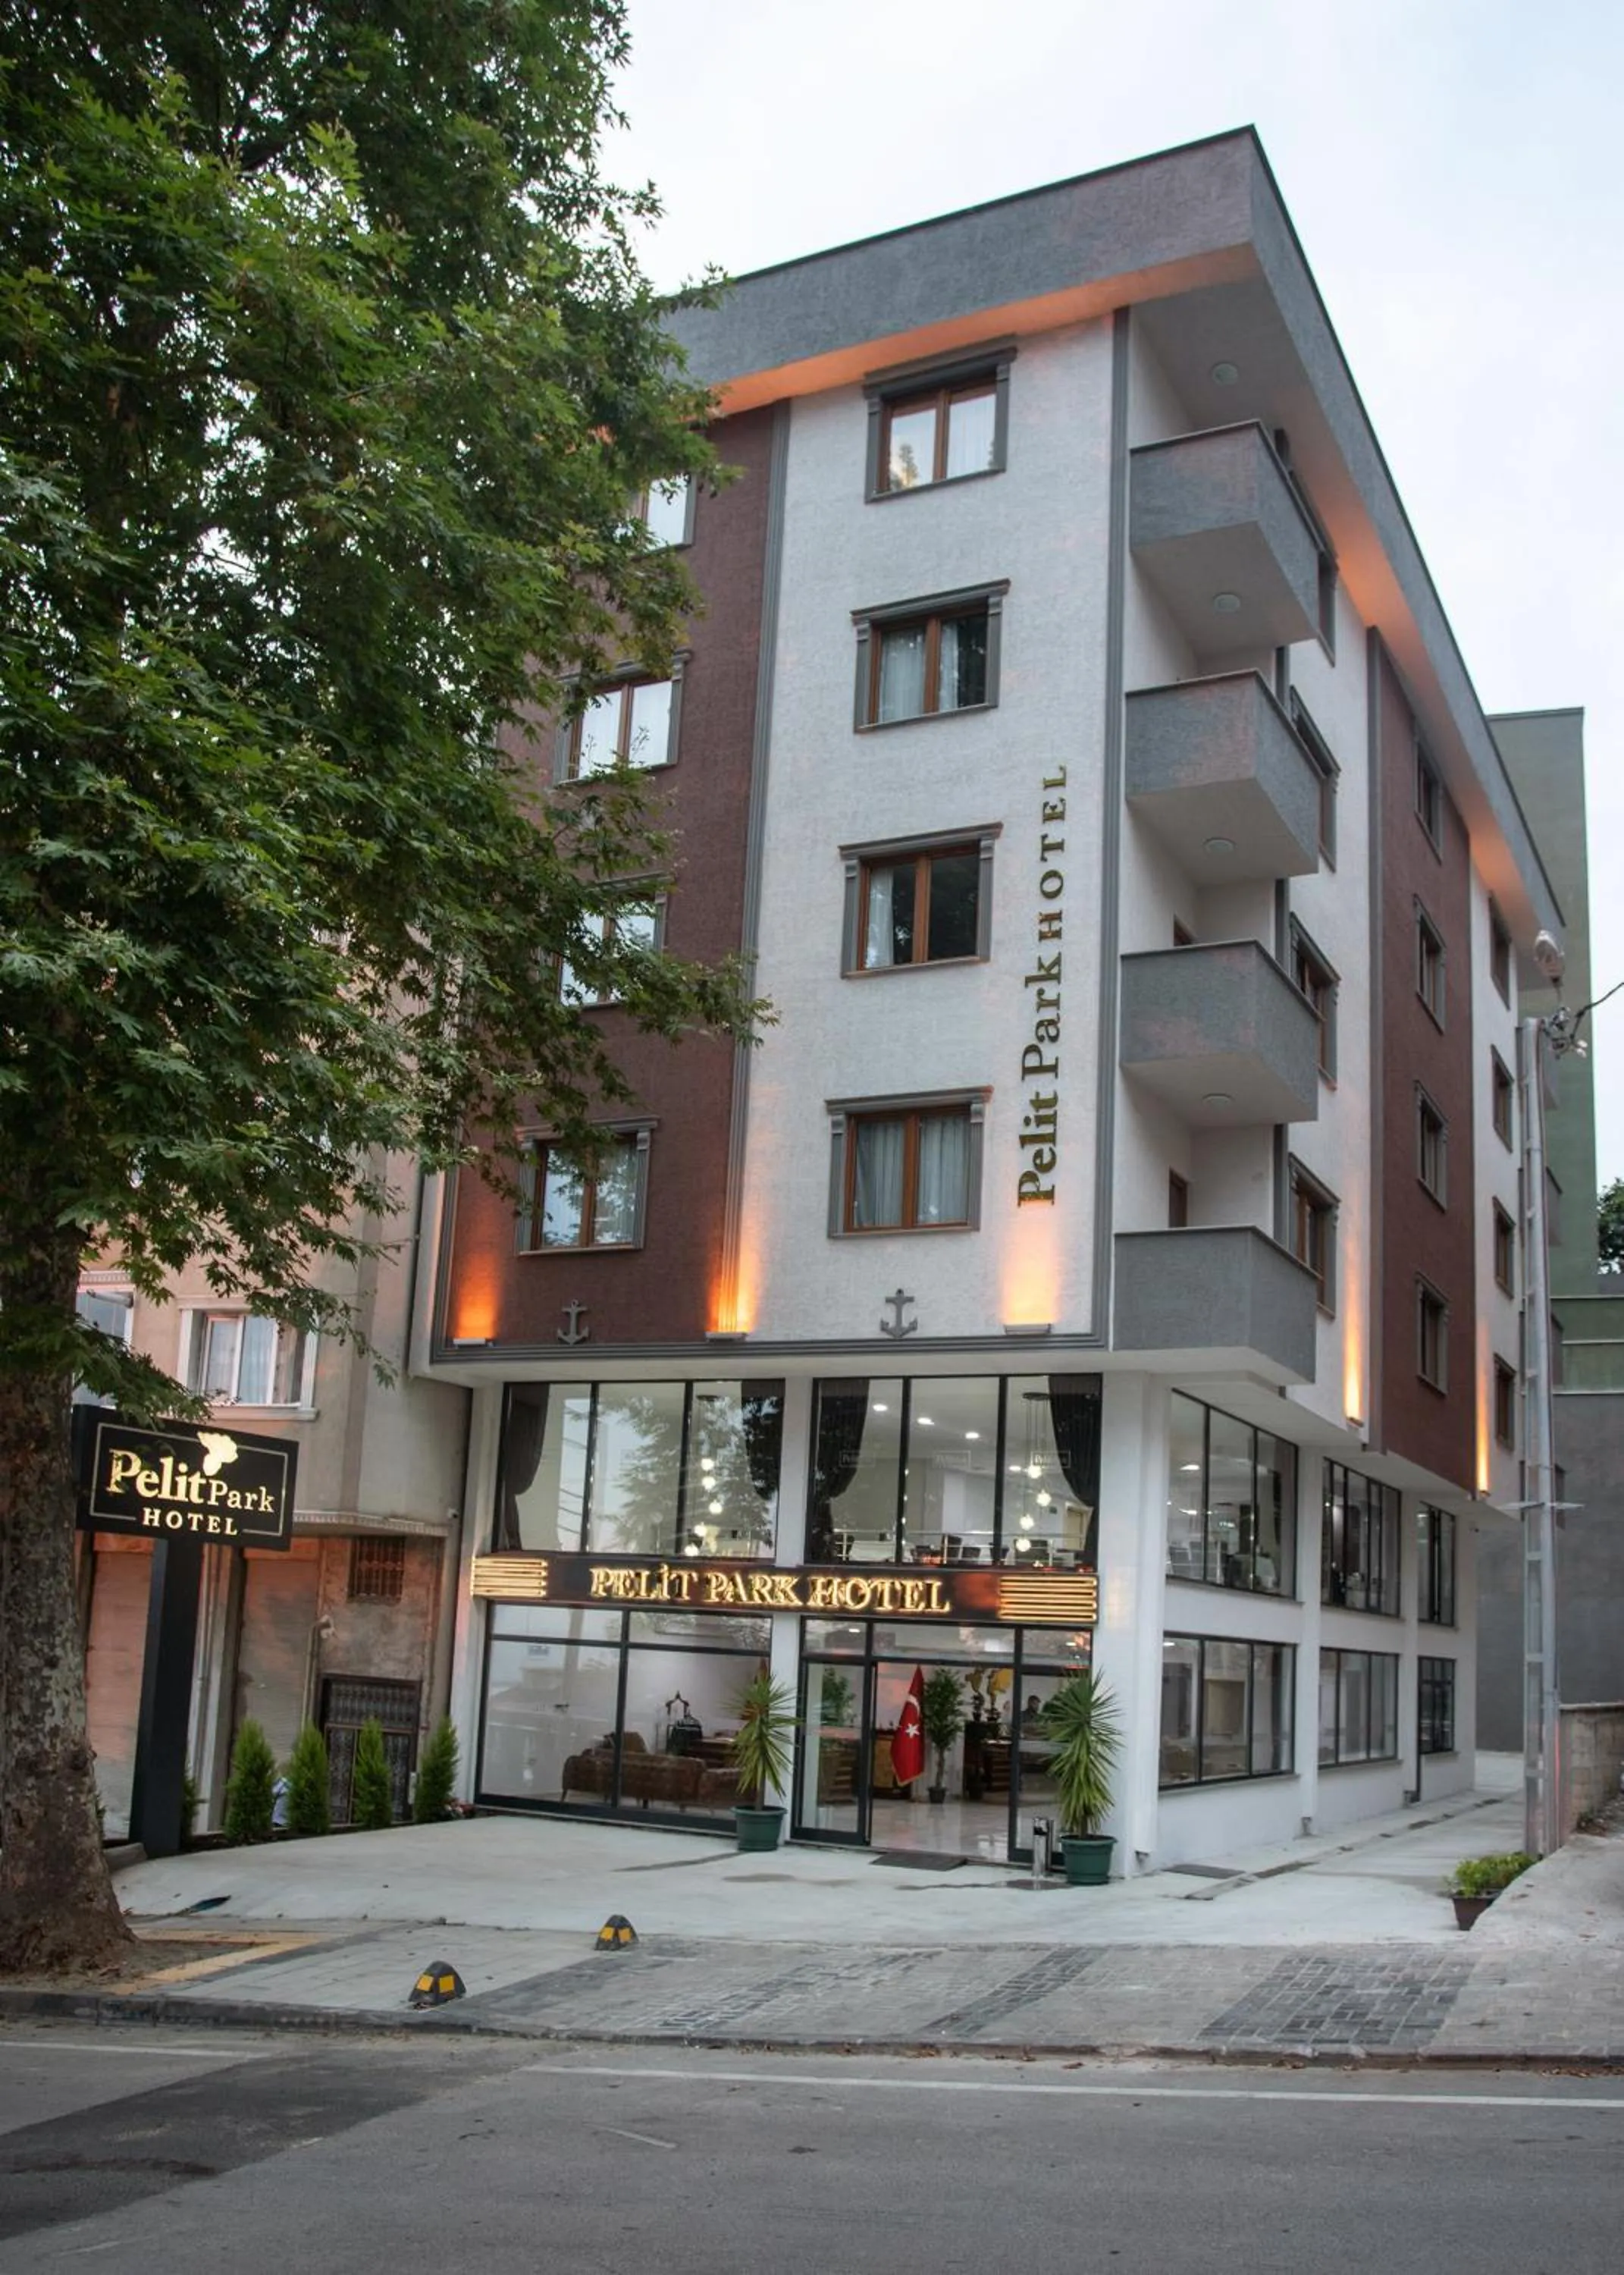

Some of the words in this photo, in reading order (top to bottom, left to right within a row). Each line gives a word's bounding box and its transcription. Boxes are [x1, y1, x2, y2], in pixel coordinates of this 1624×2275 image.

[1038, 764, 1067, 943] HOTEL
[1020, 951, 1061, 1081] Park
[1017, 1090, 1059, 1207] Pelit
[142, 1507, 239, 1536] HOTEL
[702, 1571, 803, 1606] PARK
[806, 1575, 951, 1613] HOTEL
